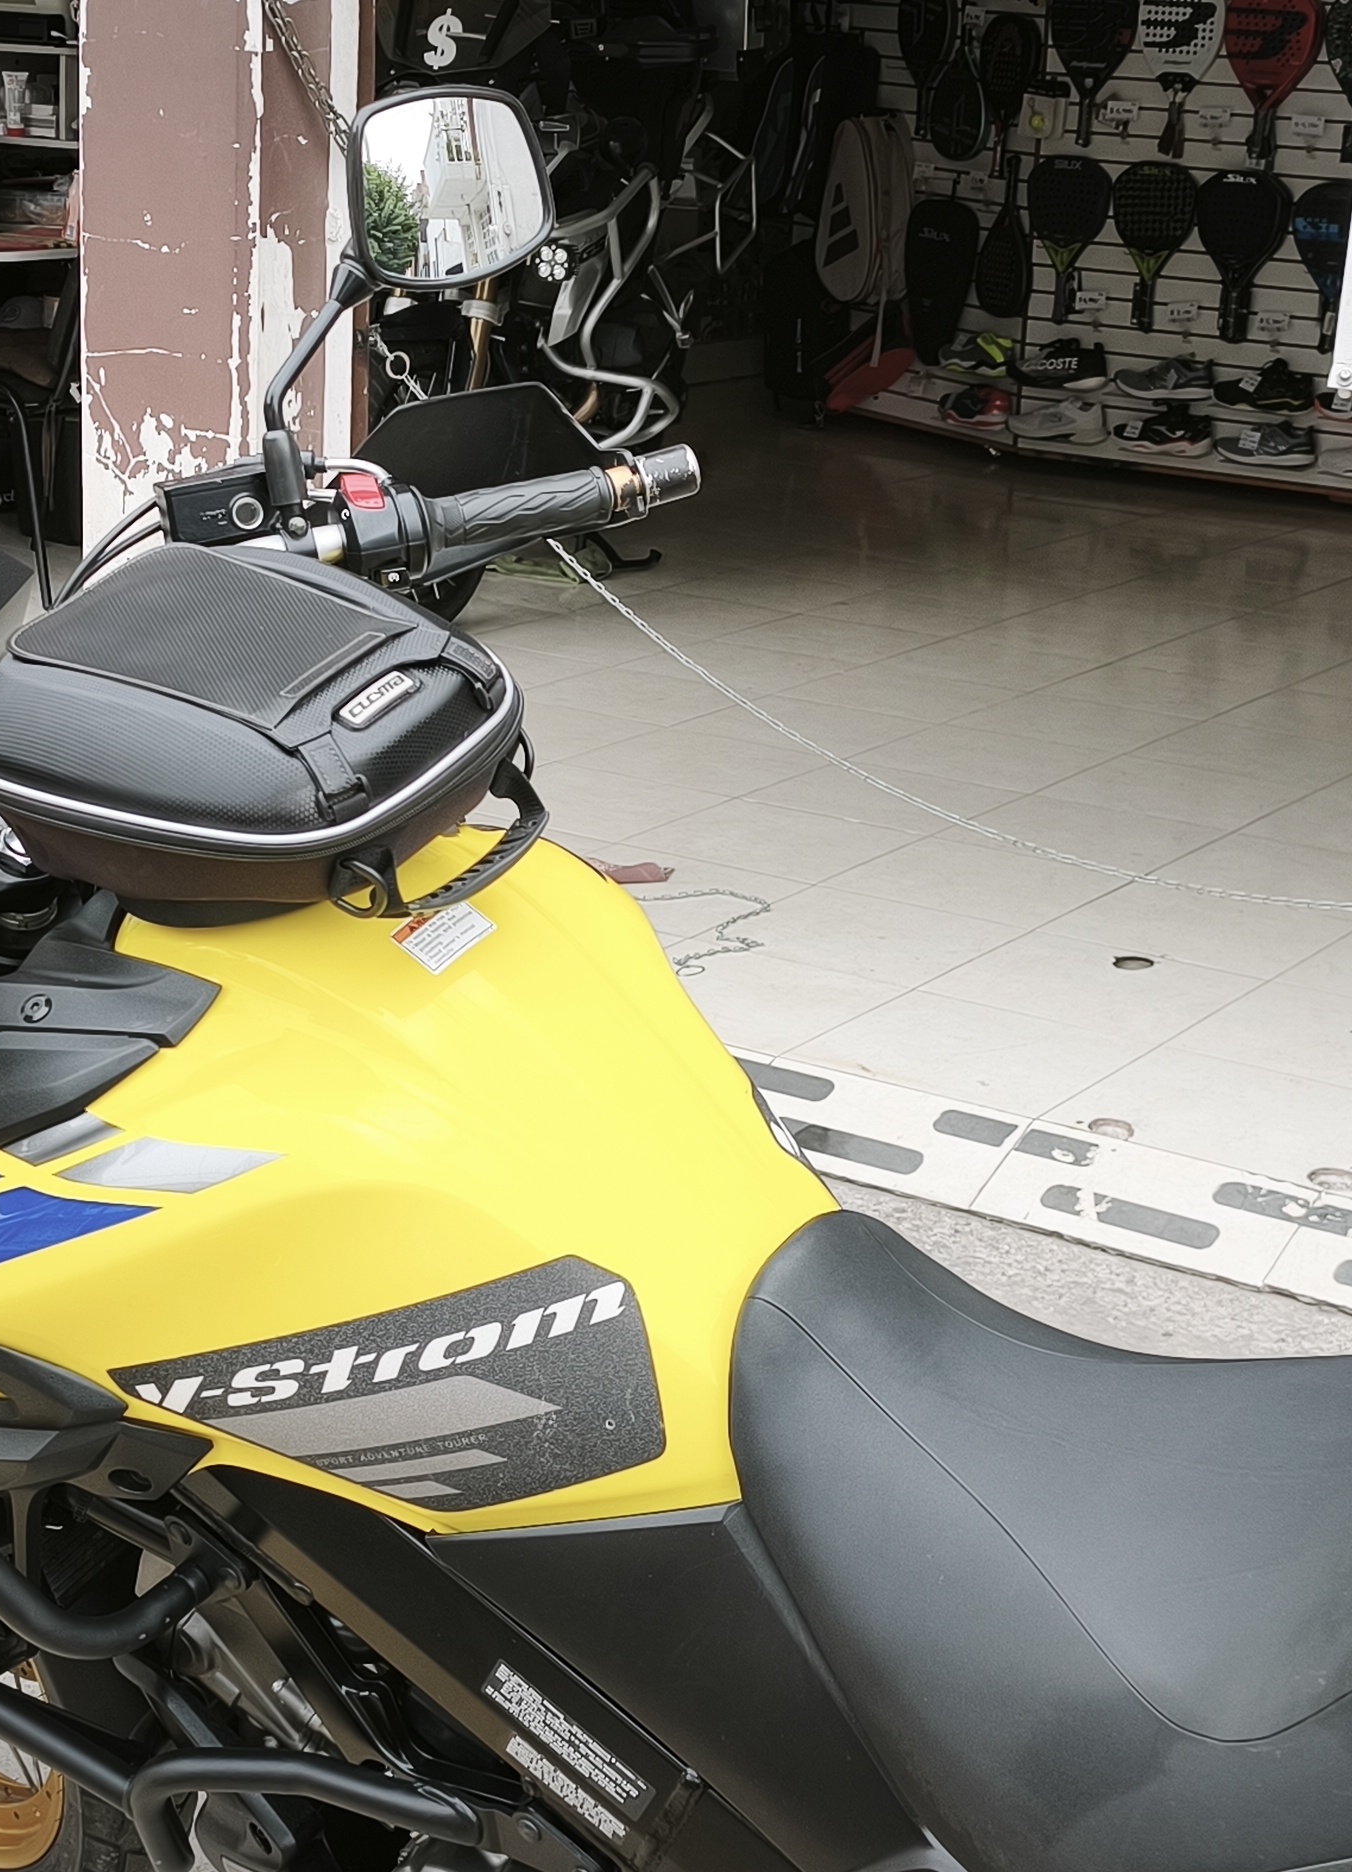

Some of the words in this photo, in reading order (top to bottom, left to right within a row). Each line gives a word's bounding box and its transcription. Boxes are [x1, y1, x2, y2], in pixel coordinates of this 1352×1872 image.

[134, 1280, 627, 1415] V-Strom
[316, 1456, 354, 1467] SPORT
[360, 1443, 431, 1462] ADVENTURE
[437, 1433, 489, 1450] TOURER
